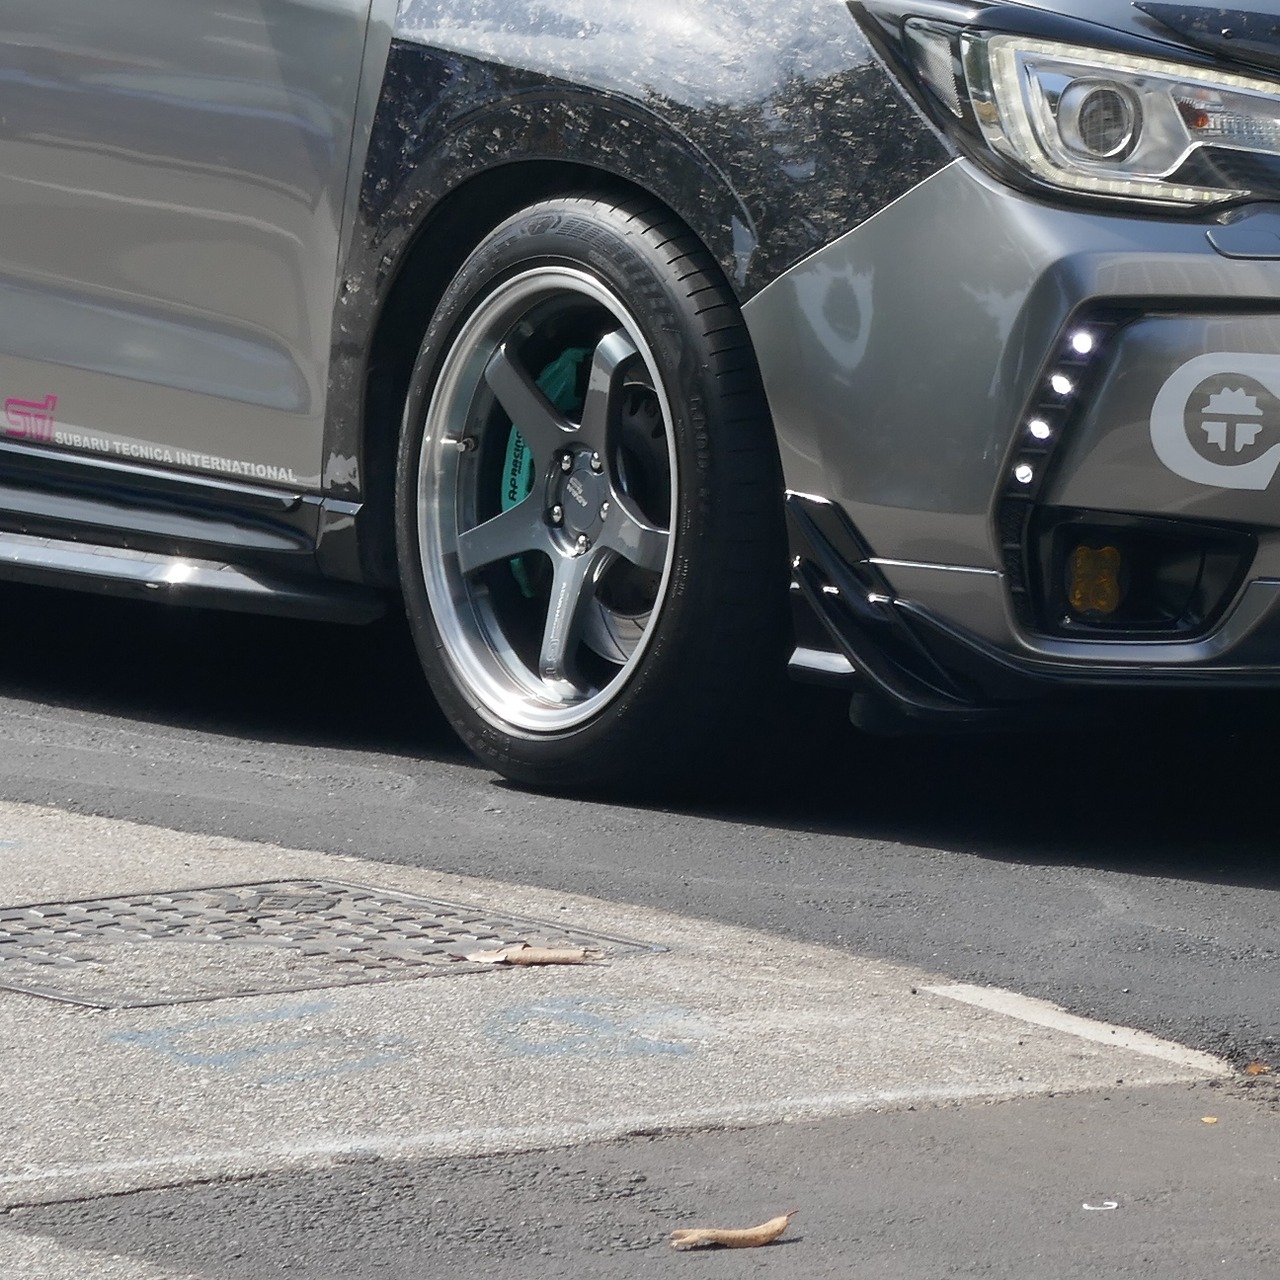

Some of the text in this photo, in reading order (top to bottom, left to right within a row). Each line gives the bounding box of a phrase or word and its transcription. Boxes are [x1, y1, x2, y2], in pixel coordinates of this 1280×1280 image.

[54, 430, 298, 483] SUBARU TECNICA INTERNATIONAL
